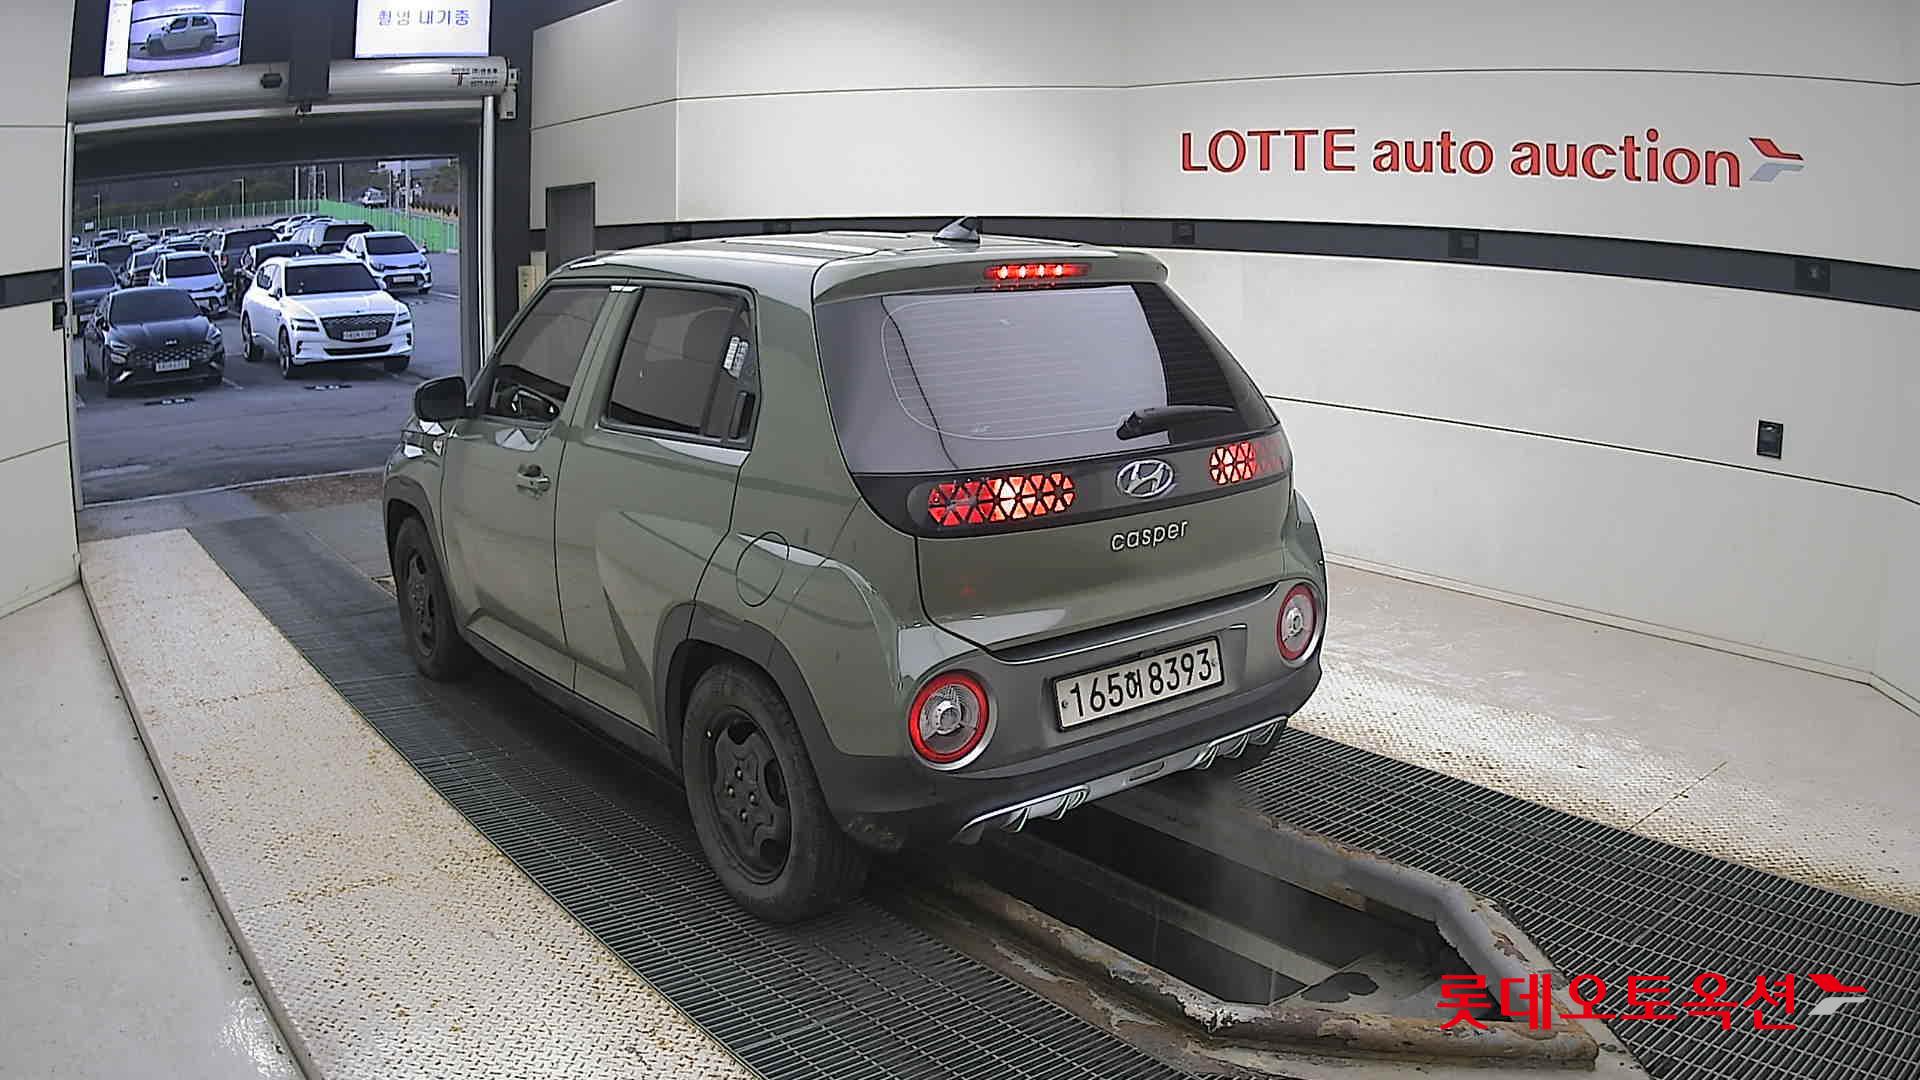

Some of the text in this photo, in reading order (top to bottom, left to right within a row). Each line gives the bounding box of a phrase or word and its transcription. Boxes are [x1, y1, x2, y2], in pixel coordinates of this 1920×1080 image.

[1181, 129, 1742, 188] LOTTE auto auction
[1111, 520, 1189, 551] casper
